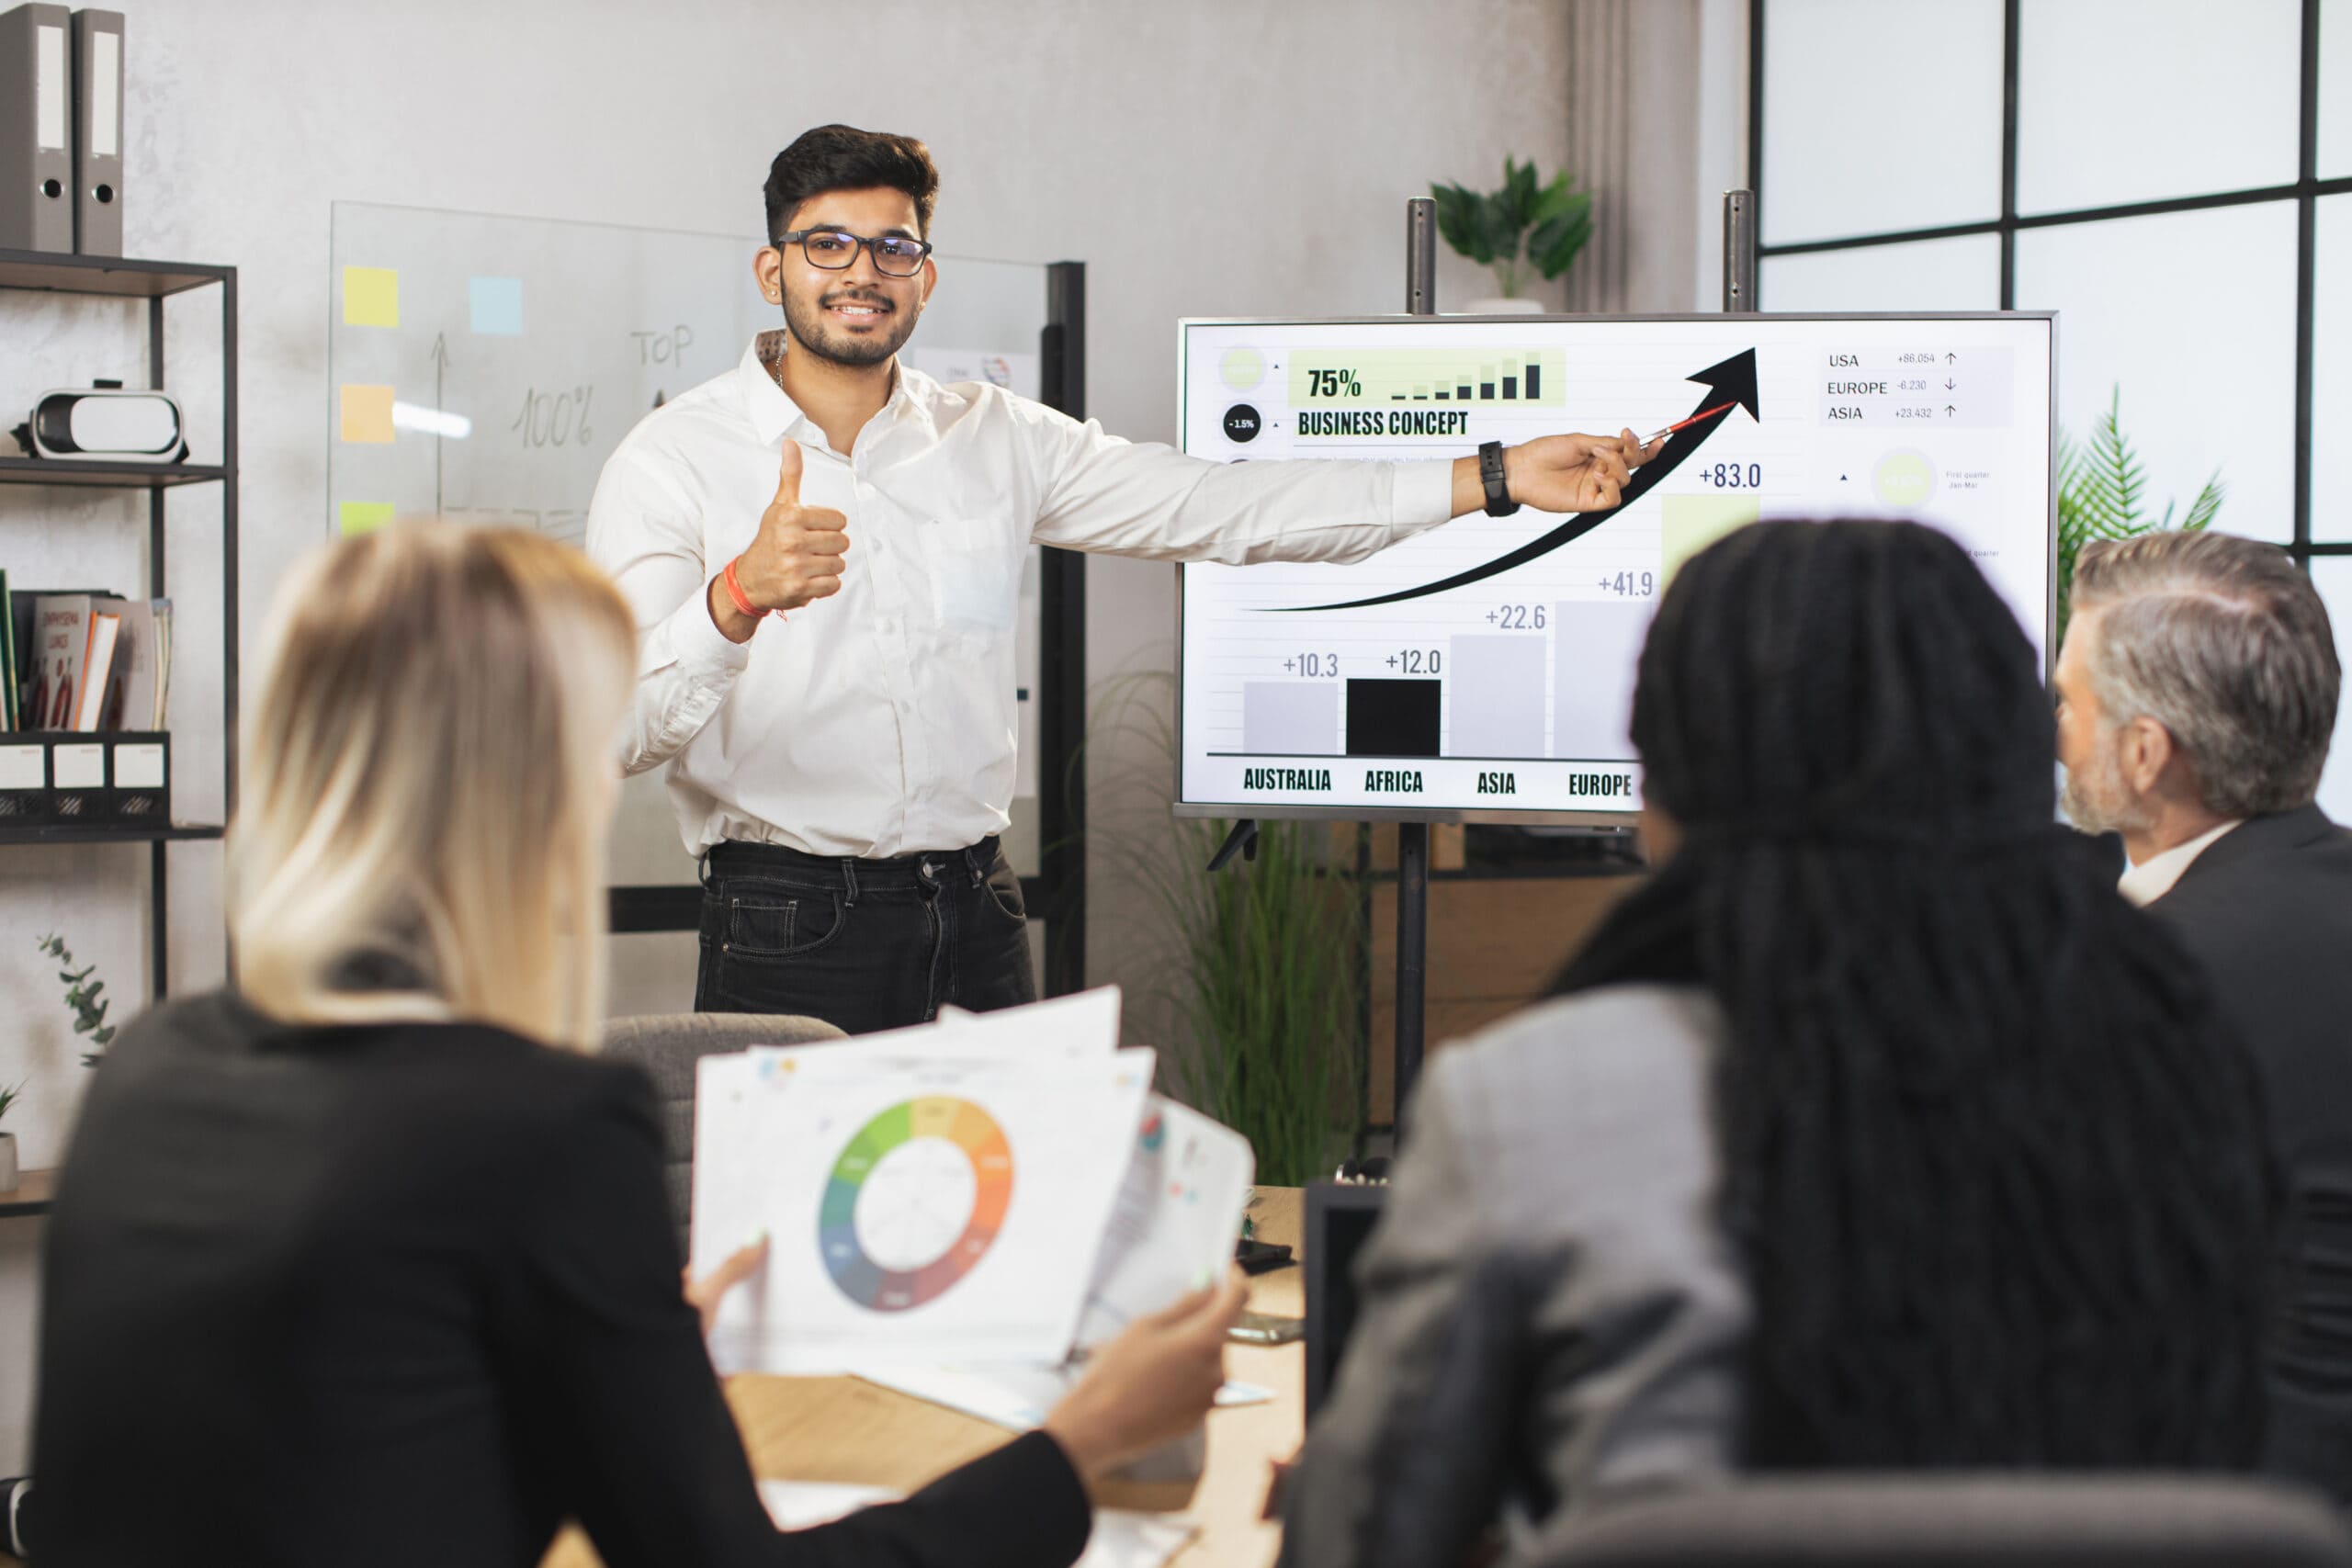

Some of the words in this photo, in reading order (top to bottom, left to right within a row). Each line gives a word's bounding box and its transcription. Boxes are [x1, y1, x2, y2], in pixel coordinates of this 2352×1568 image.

[631, 324, 693, 367] TOP
[1829, 355, 1859, 367] USA
[1307, 369, 1362, 398] 75%
[1827, 382, 1888, 395] EUROPE
[512, 385, 594, 448] 100%
[1298, 412, 1384, 435] BUSINESS
[1389, 411, 1469, 435] CONCEPT
[1827, 407, 1862, 419] ASIA
[1700, 463, 1761, 489] +83.0
[1599, 571, 1653, 596] +41.9
[1486, 605, 1545, 630] +22.6
[1283, 652, 1339, 678] +10.3
[1385, 649, 1442, 674] +12.0
[1243, 768, 1331, 792] AUSTRALIA
[1364, 770, 1423, 793] AFRICA
[1477, 772, 1516, 795] ASIA
[1568, 773, 1632, 796] EUROPE
